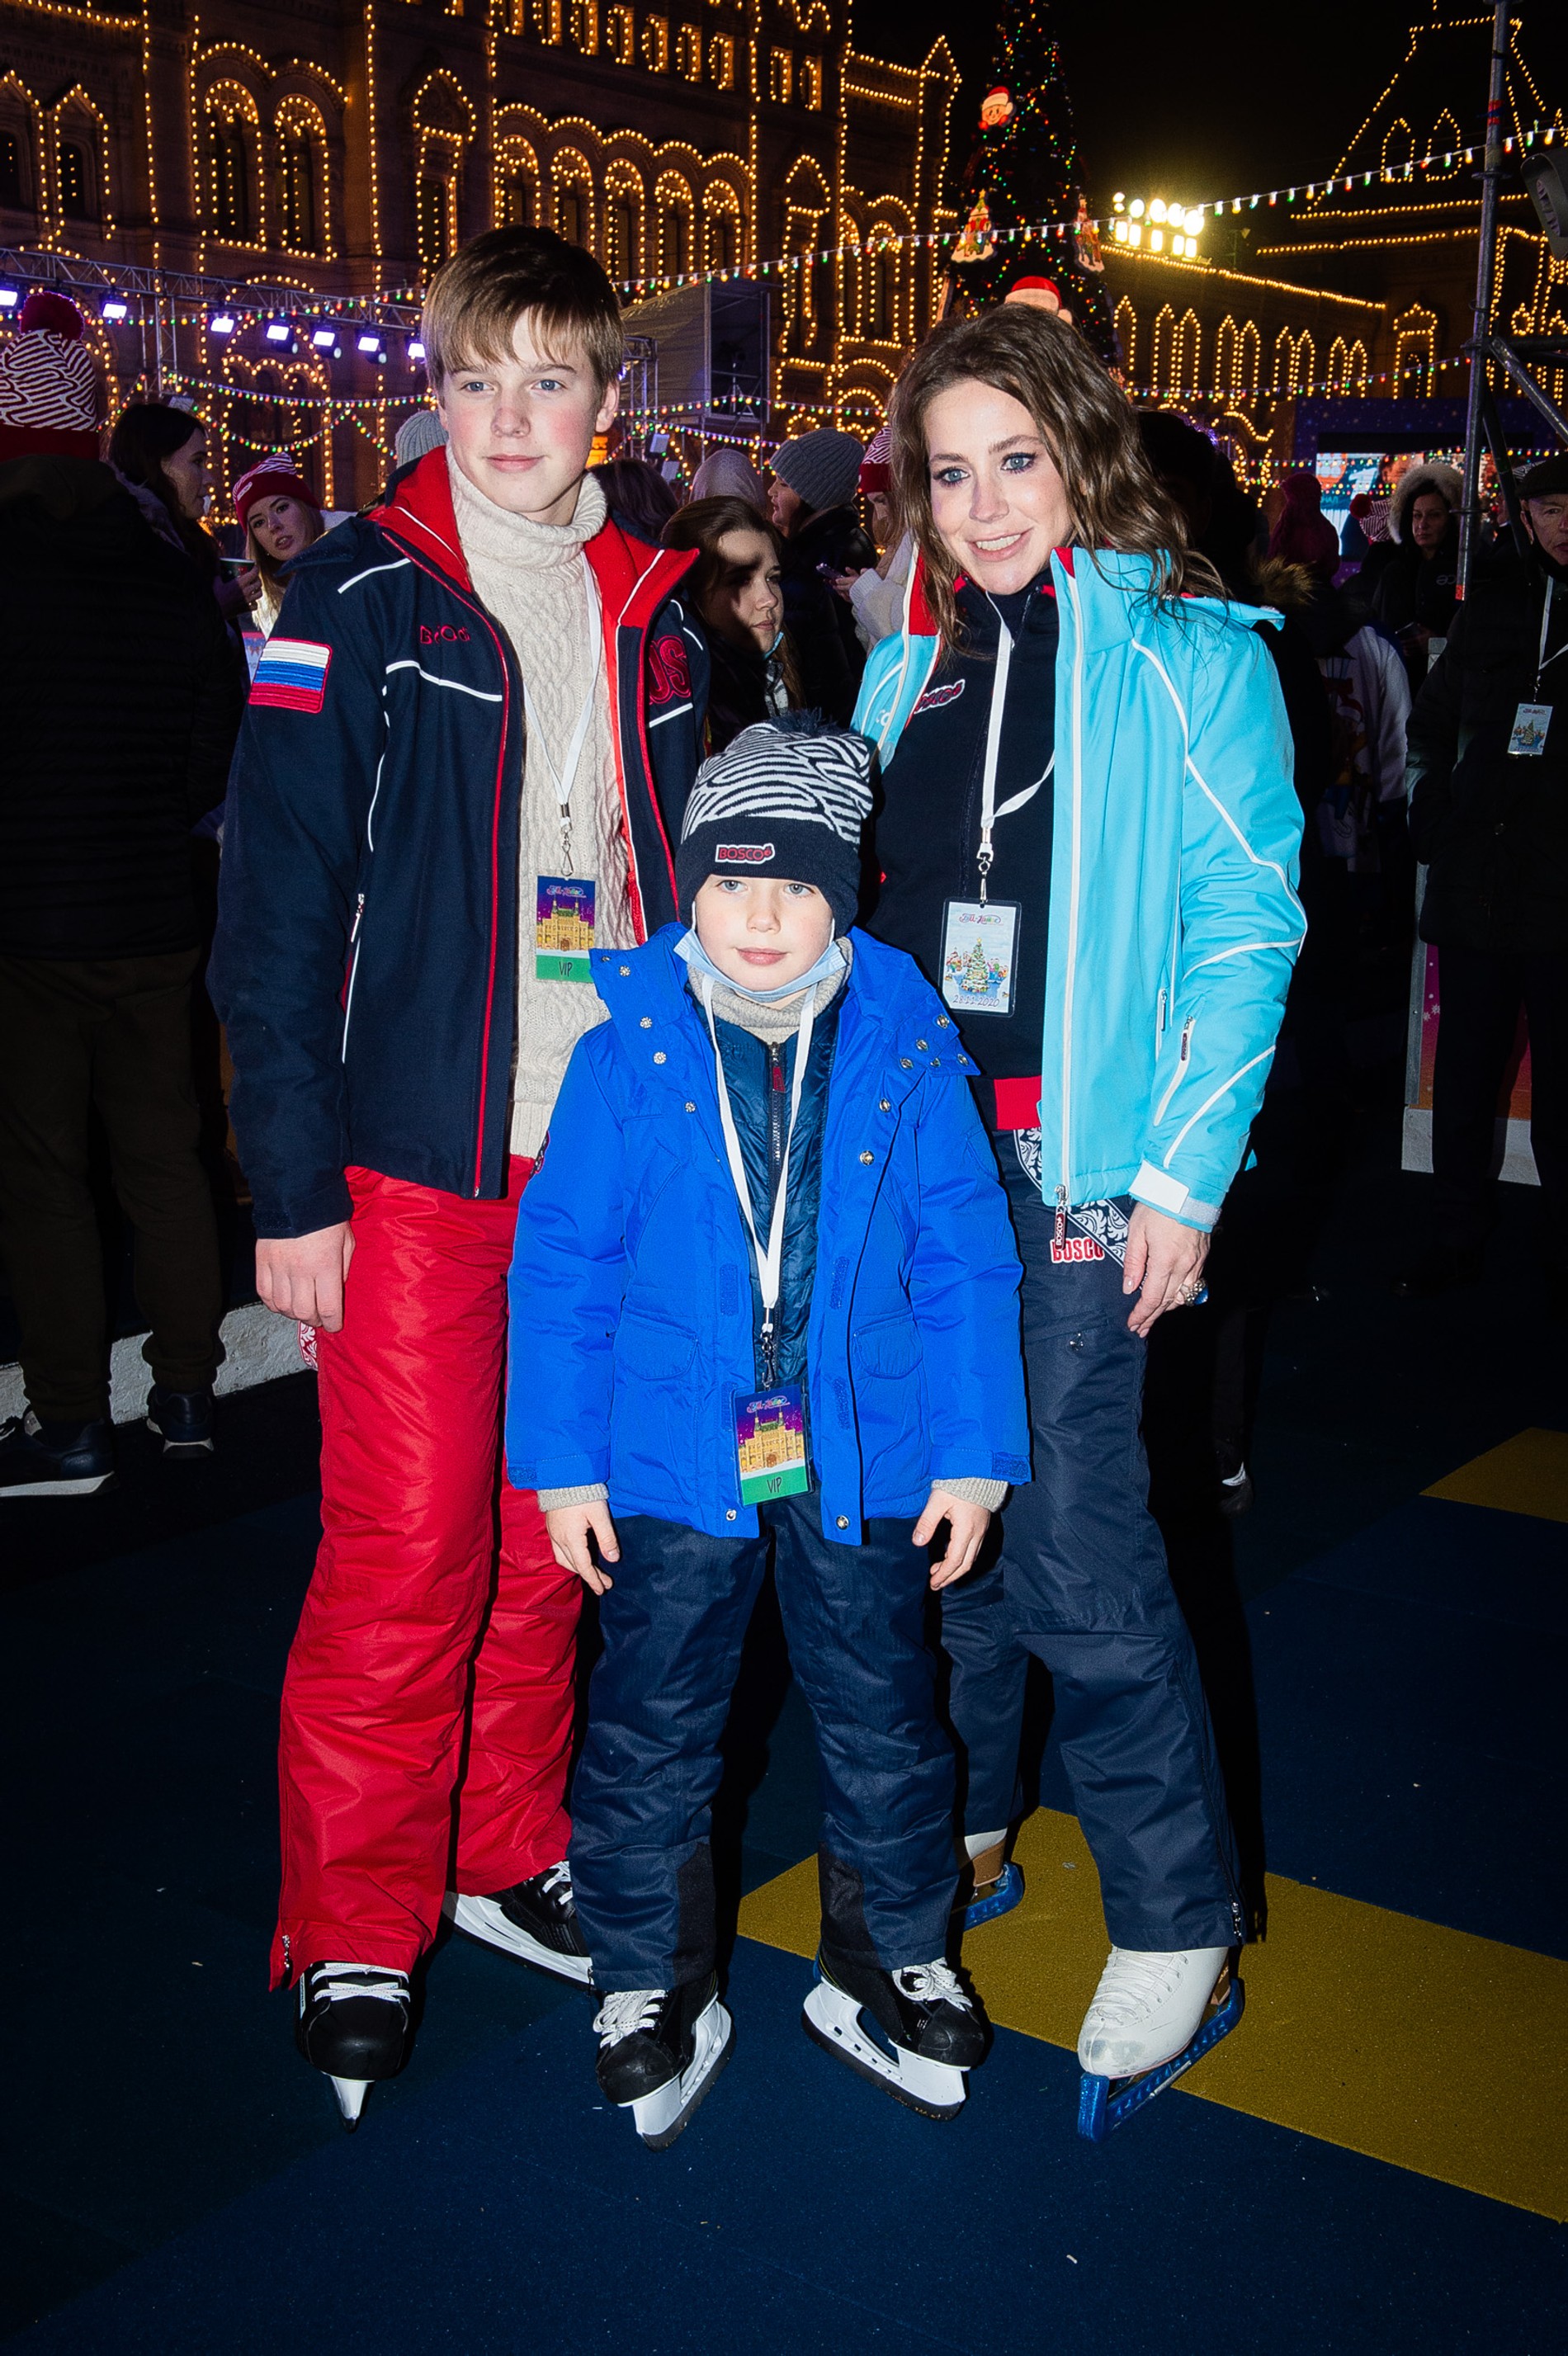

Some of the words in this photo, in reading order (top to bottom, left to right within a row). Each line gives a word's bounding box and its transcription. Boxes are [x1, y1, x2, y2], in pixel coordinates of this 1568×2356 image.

[718, 847, 765, 862] BOSCO
[558, 961, 574, 978] VIP
[1056, 1221, 1064, 1246] BOSCO
[766, 1476, 783, 1494] VIP
